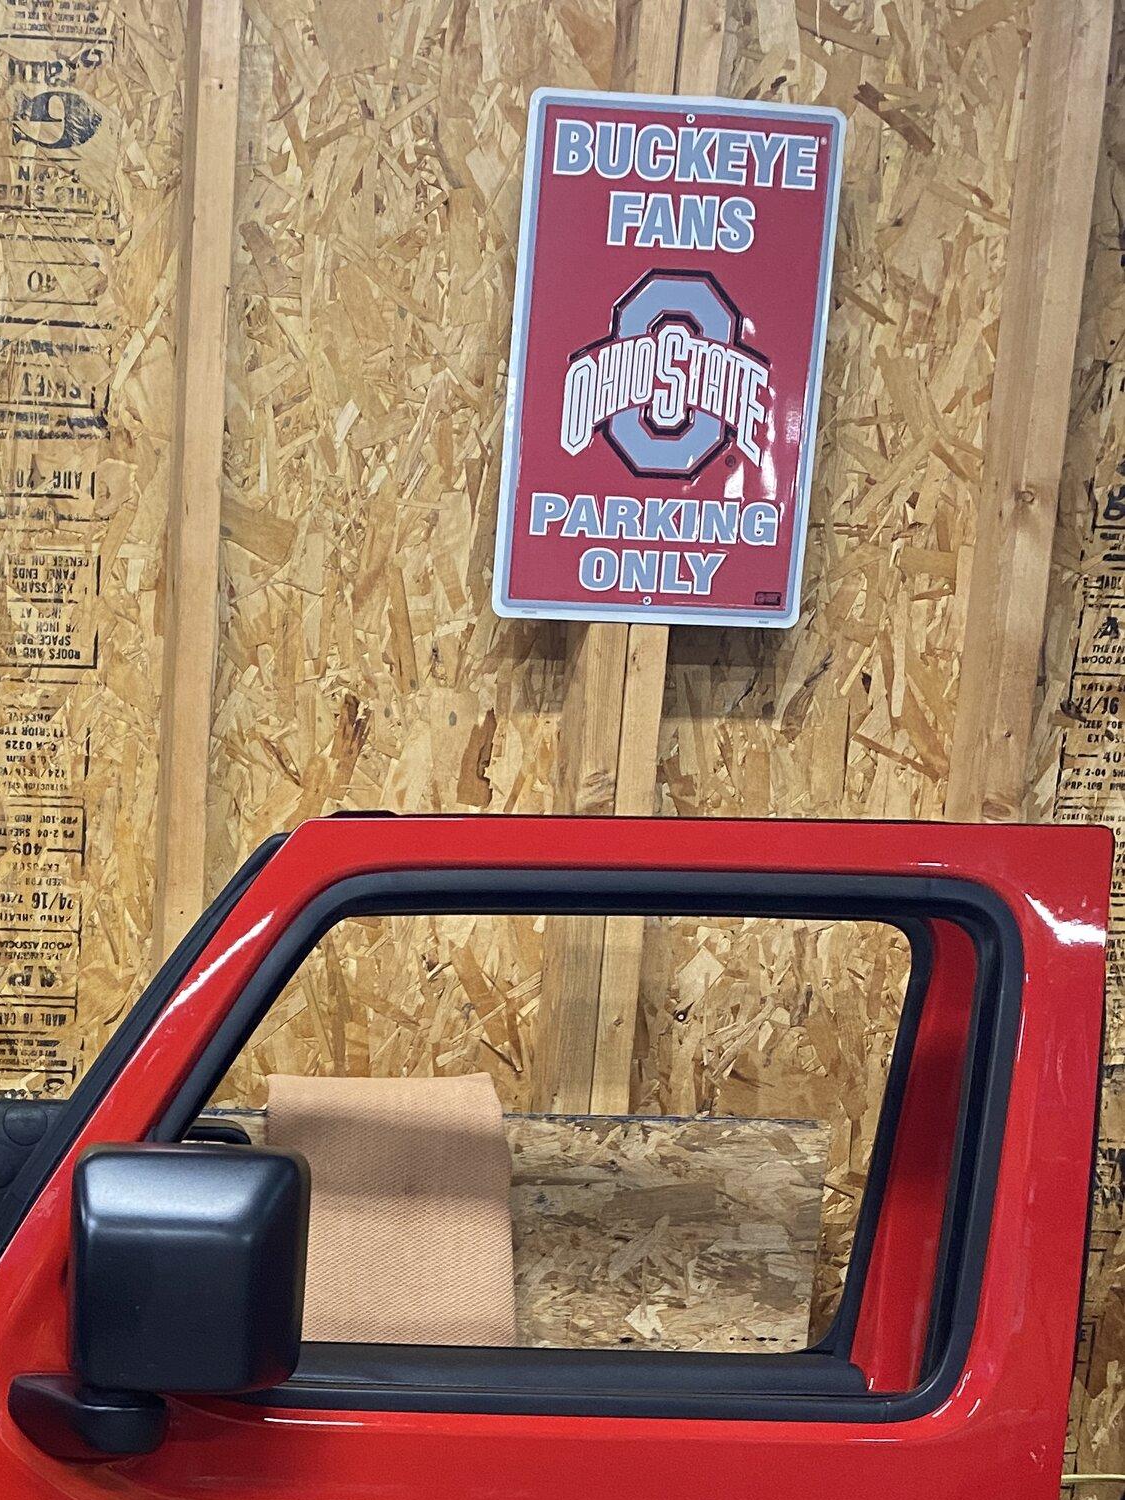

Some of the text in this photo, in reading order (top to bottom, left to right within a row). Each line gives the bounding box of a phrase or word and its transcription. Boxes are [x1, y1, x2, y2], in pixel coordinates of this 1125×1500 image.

[553, 119, 819, 190] BUCKEYE
[606, 191, 756, 253] FANS
[561, 325, 770, 467] OHIO STATE
[529, 492, 780, 546] PARKING
[13, 568, 38, 578] ENDS
[579, 547, 728, 595] ONLY
[49, 648, 81, 659] ROOFS
[12, 842, 43, 855] 409
[40, 1013, 67, 1027] MADE
